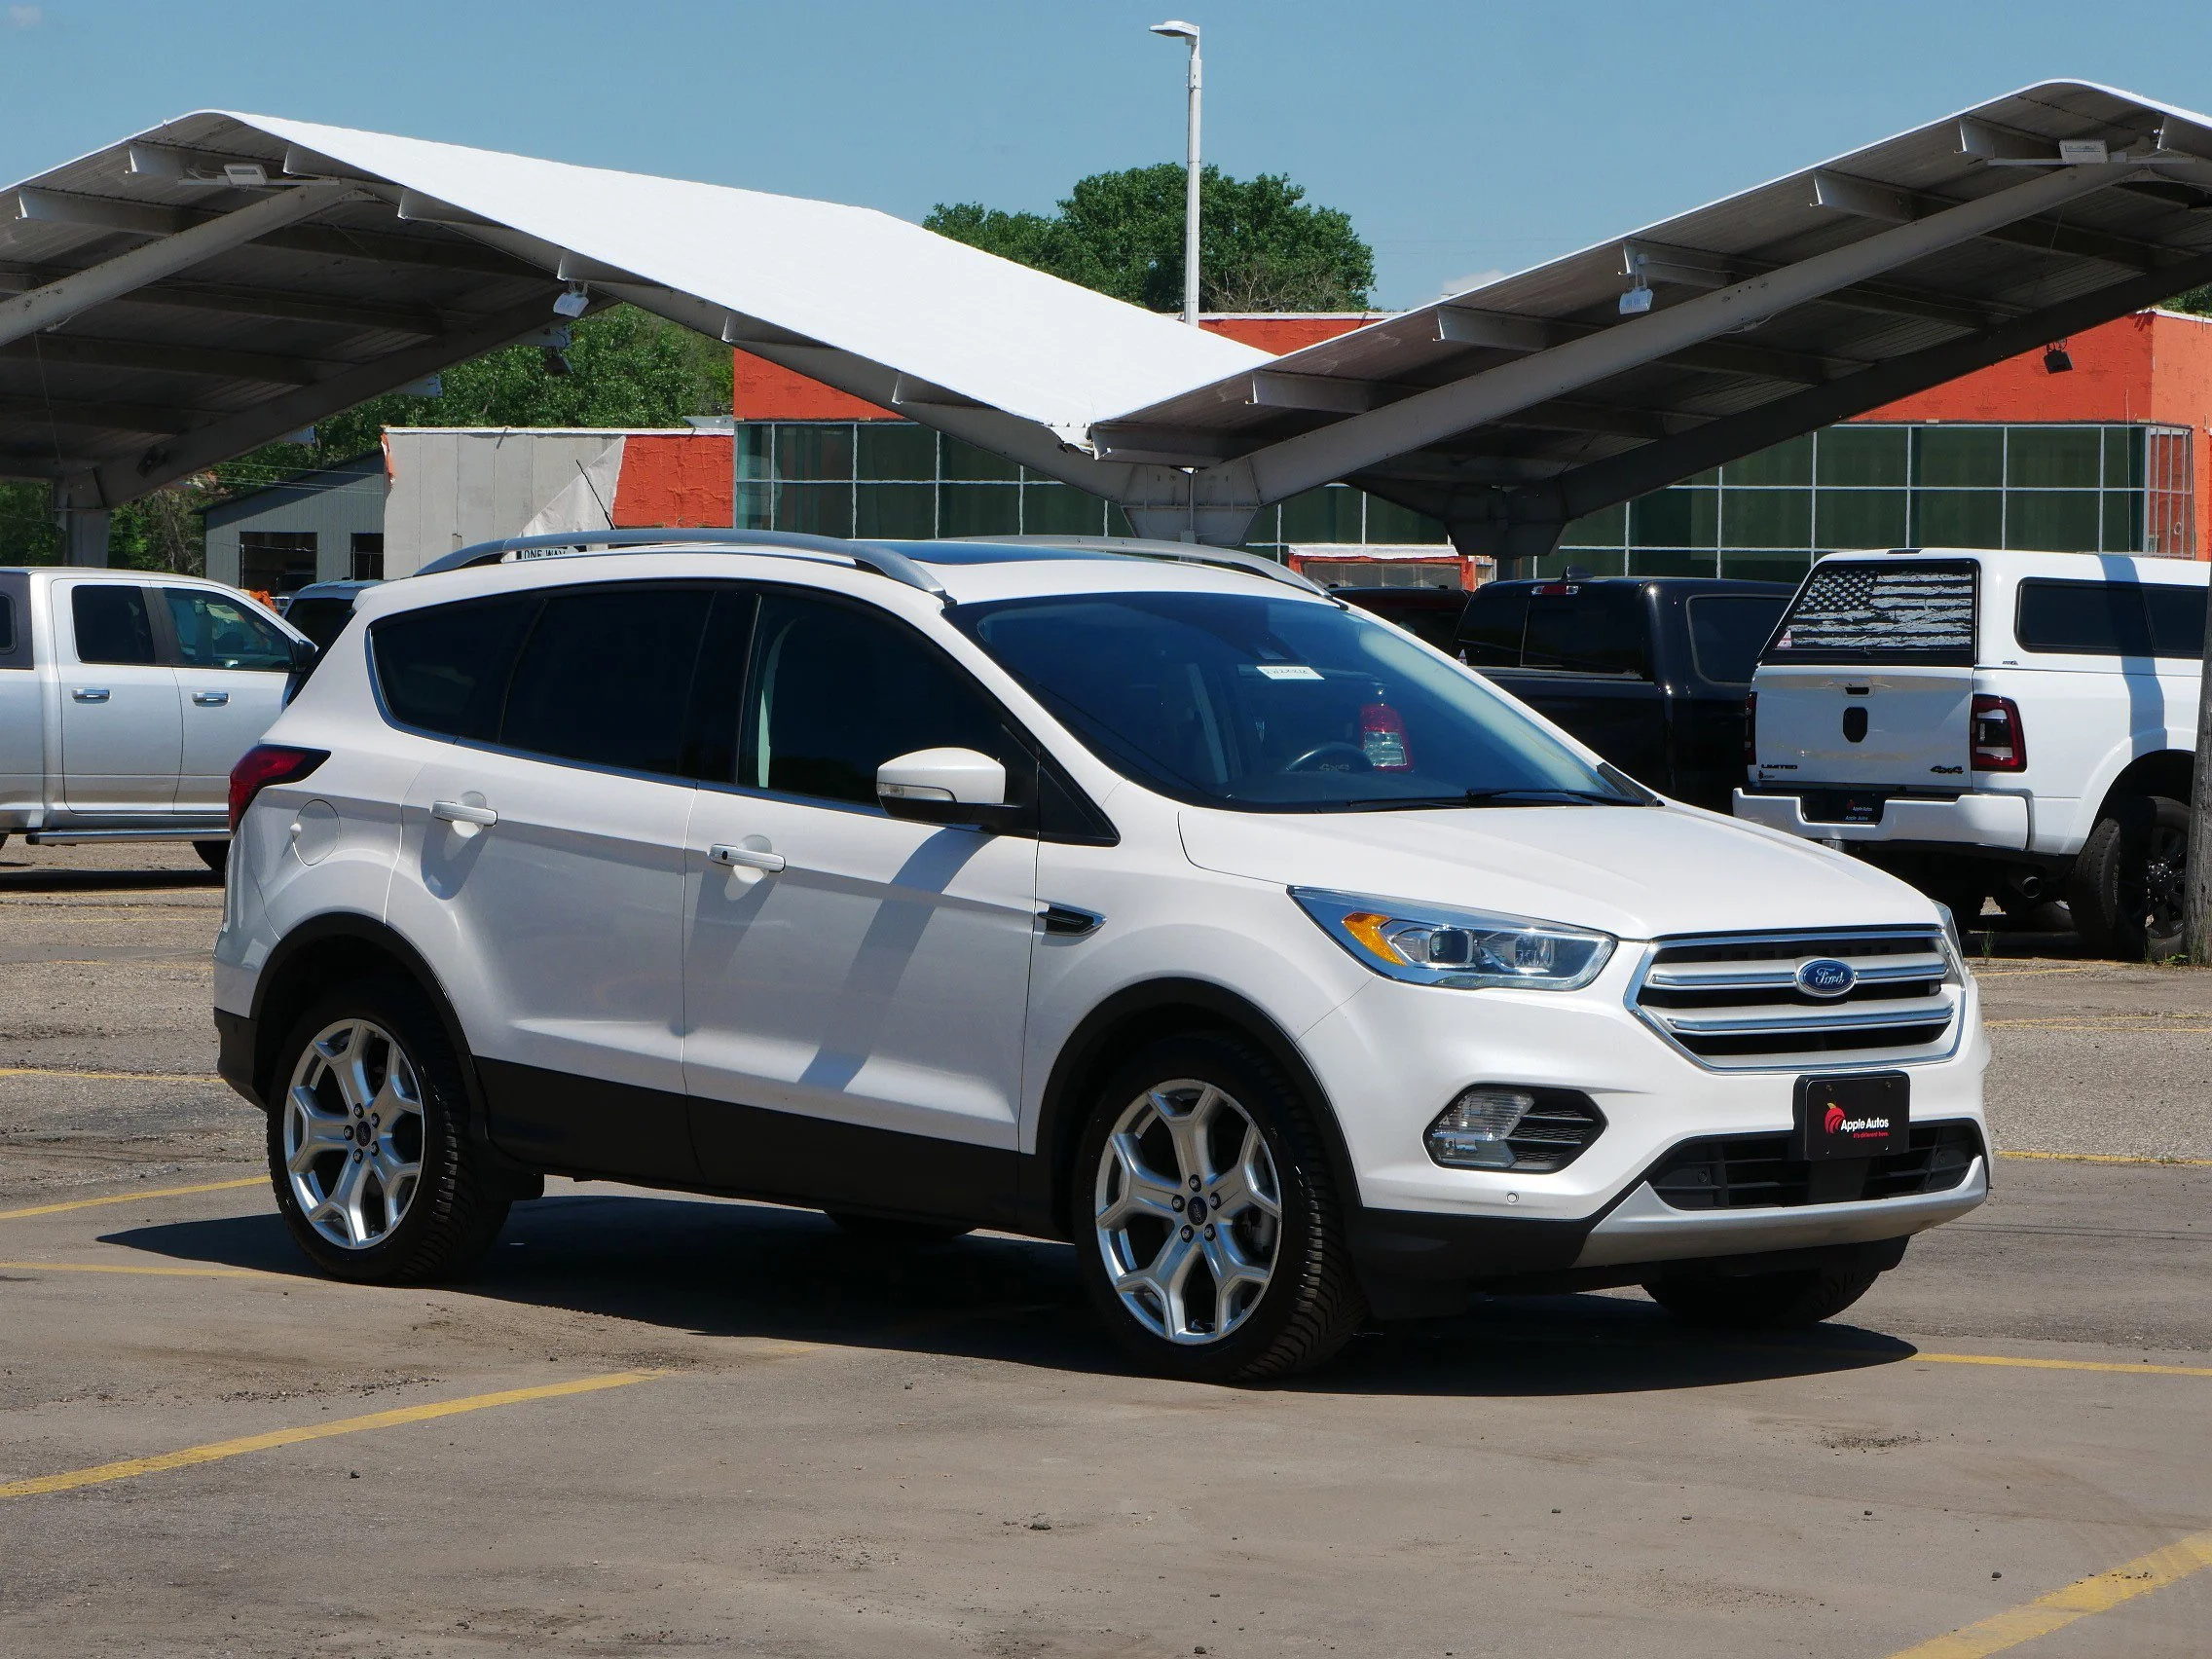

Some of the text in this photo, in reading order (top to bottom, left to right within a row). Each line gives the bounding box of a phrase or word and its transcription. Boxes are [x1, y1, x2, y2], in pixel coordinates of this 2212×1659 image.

[524, 549, 542, 560] ONE
[1815, 967, 1845, 985] Ford
[1840, 1117, 1889, 1132] Apple Autos
